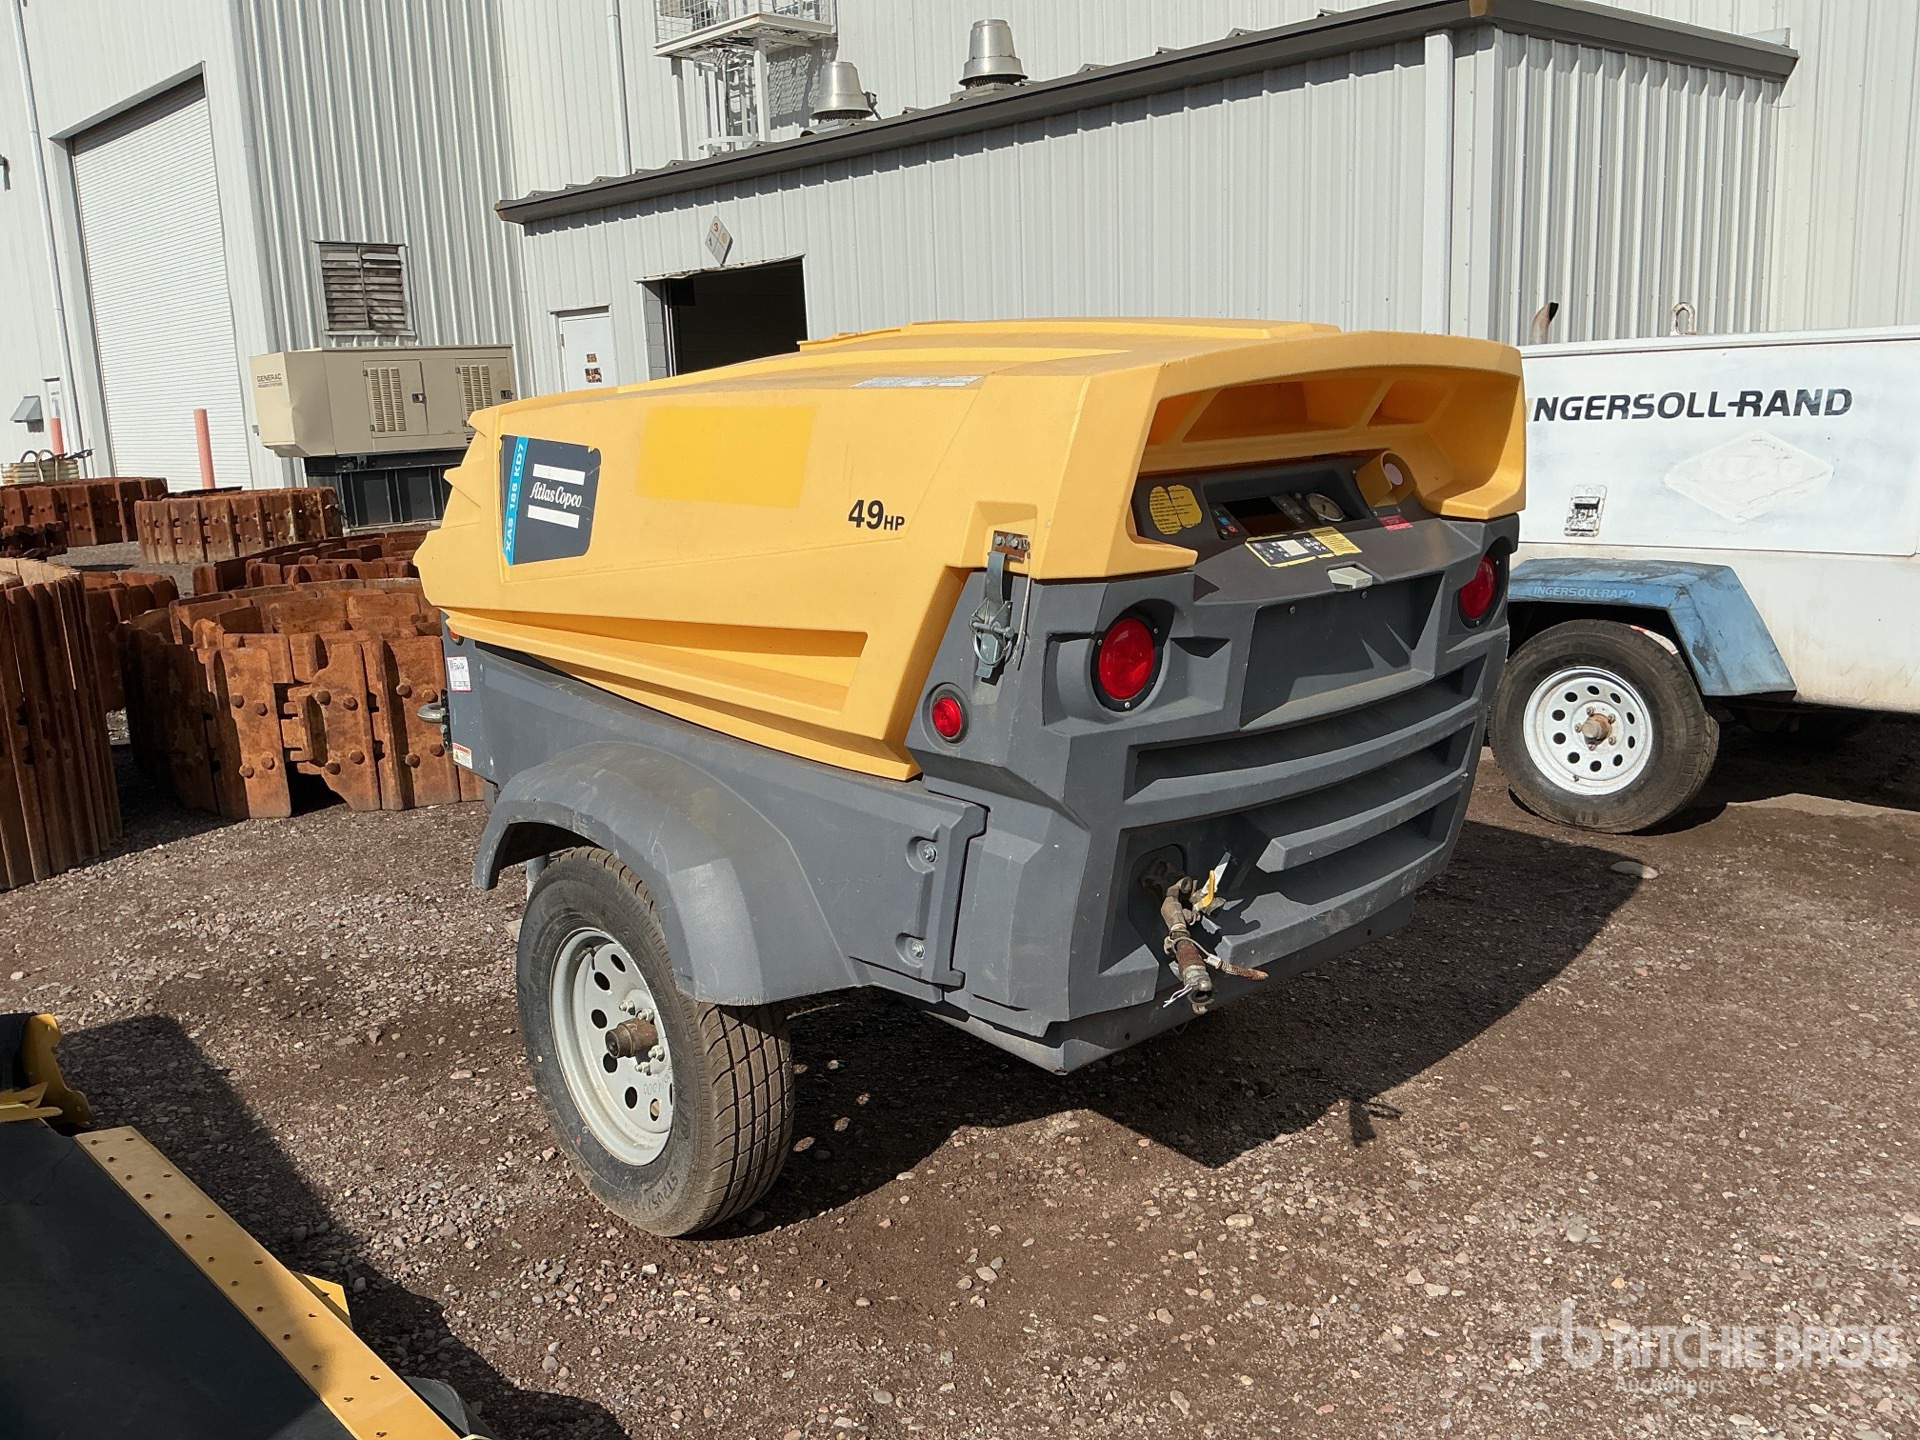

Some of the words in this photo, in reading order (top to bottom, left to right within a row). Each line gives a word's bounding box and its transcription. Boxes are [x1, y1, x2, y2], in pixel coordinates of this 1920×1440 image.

[714, 222, 718, 232] 3
[256, 373, 282, 382] GENERAC
[505, 518, 514, 552] XAS
[514, 443, 525, 476] KD7
[529, 481, 556, 504] Atlas
[555, 486, 582, 509] Copco
[1533, 586, 1637, 599] INGERSOLL-RAND
